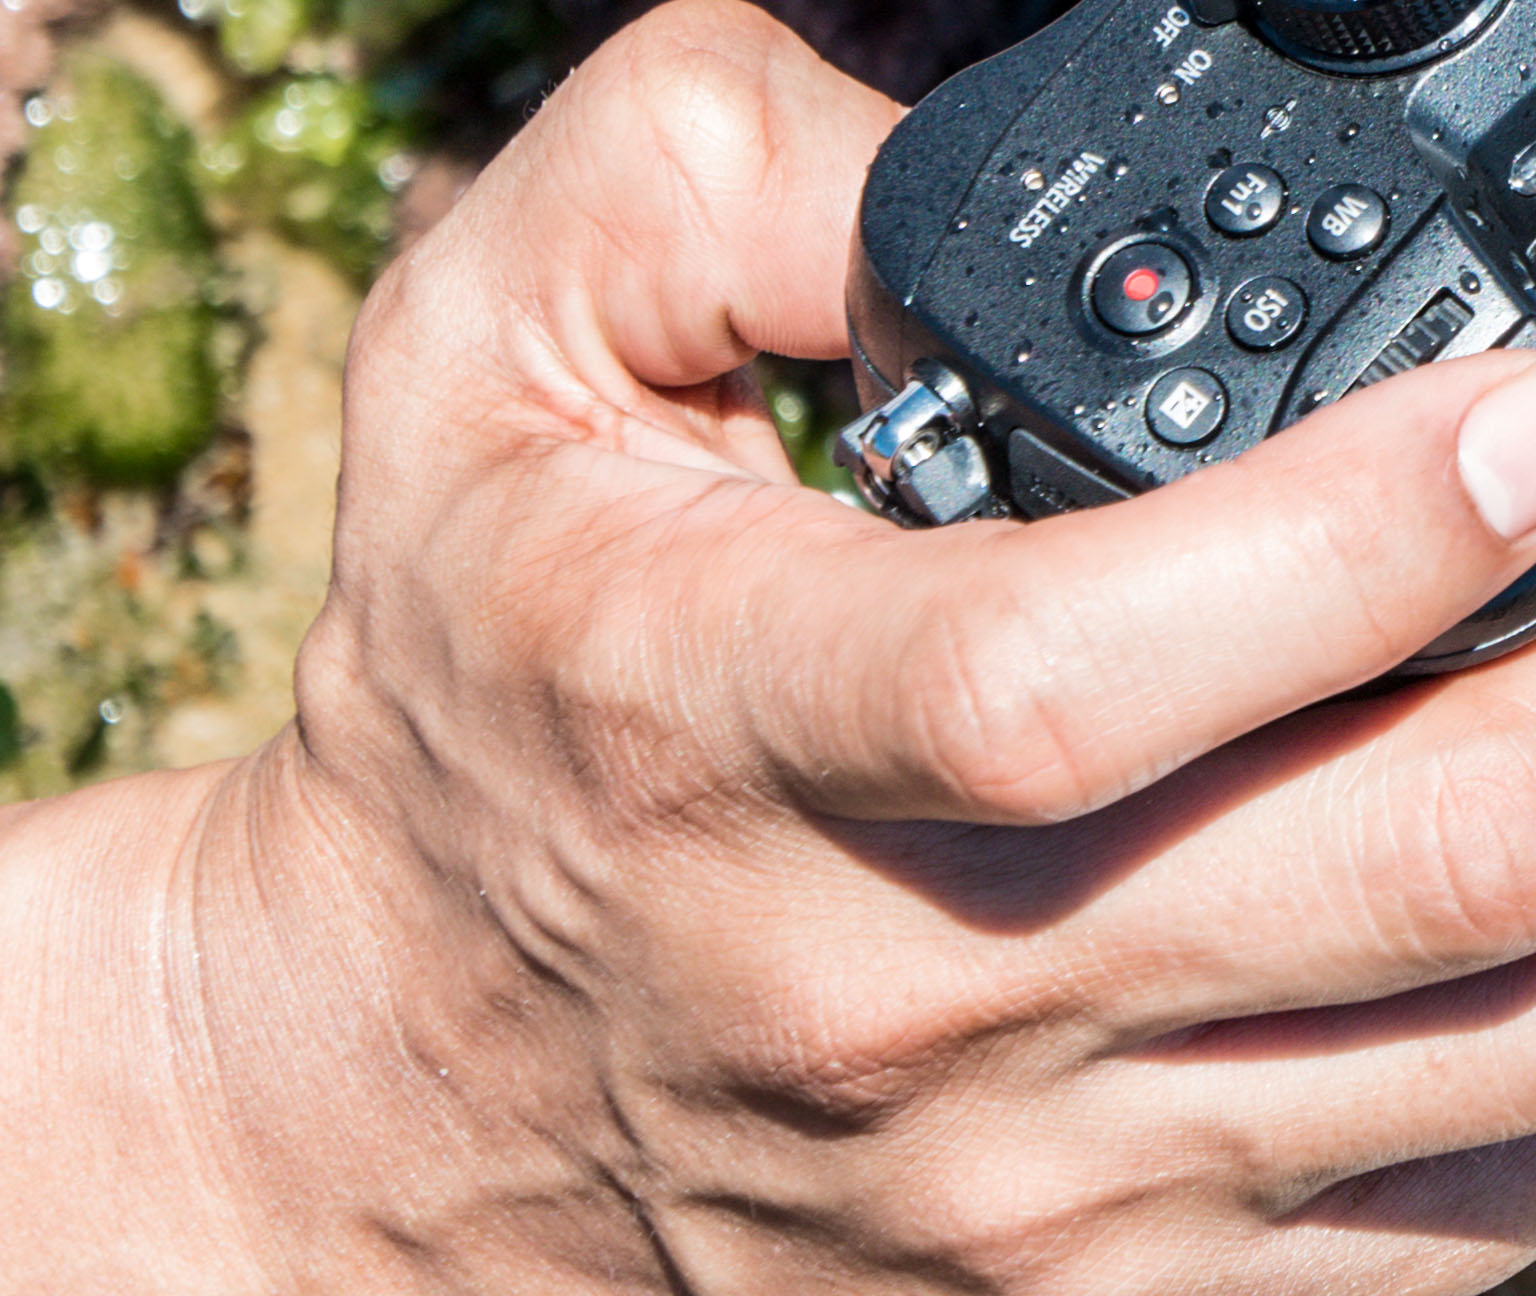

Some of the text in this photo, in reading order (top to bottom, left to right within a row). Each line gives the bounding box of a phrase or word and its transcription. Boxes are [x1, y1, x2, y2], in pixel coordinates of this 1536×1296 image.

[1153, 6, 1190, 47] OFF
[1174, 50, 1212, 86] ON
[1009, 152, 1105, 248] WIRELESS
[1221, 172, 1268, 217] Fn1
[1321, 196, 1369, 237] WB
[1244, 289, 1289, 332] ISO
